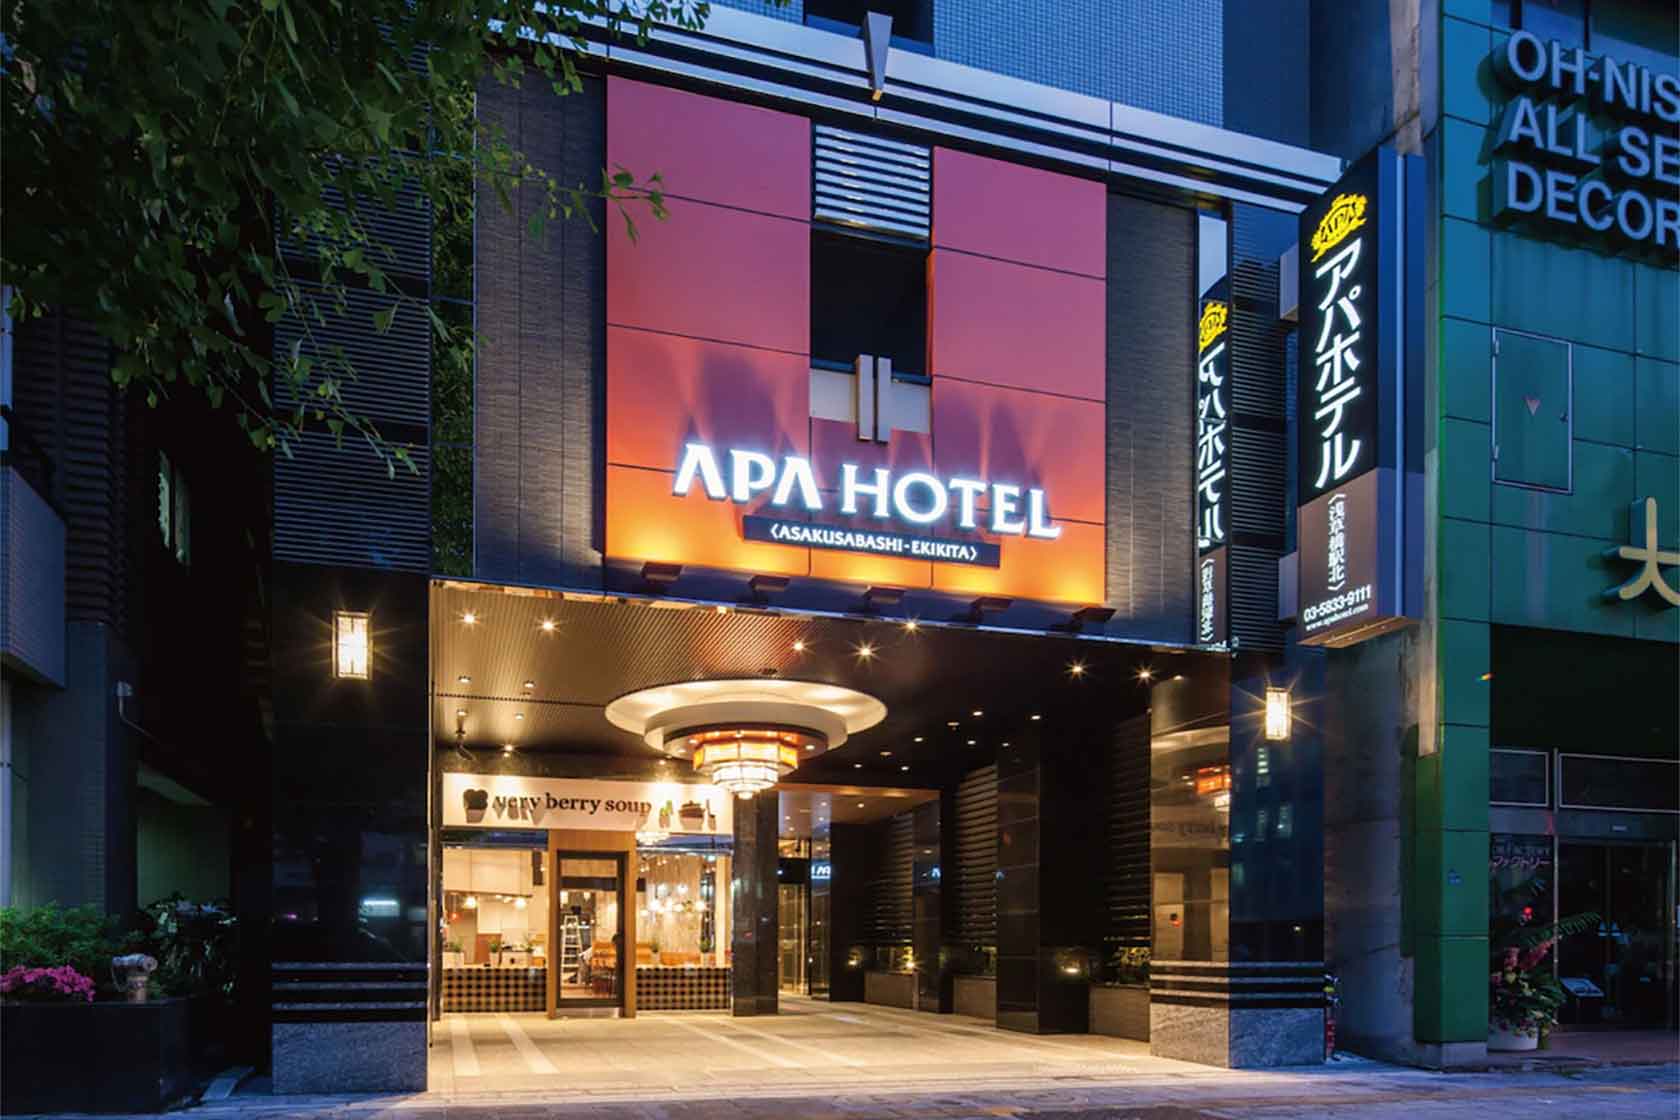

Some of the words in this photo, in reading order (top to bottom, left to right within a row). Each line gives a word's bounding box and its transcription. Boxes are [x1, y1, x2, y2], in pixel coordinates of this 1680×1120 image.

[1507, 30, 1680, 122] OH-NIS
[1508, 96, 1600, 164] ALL
[1617, 125, 1680, 186] SE
[1507, 160, 1680, 246] DECOR
[1314, 237, 1362, 489] アパホテル
[671, 442, 823, 511] APA
[840, 463, 1061, 539] HOTEL
[1303, 584, 1372, 622] 03-5833-9111
[494, 795, 542, 813] very
[546, 793, 601, 815] berry
[605, 799, 652, 817] soup
